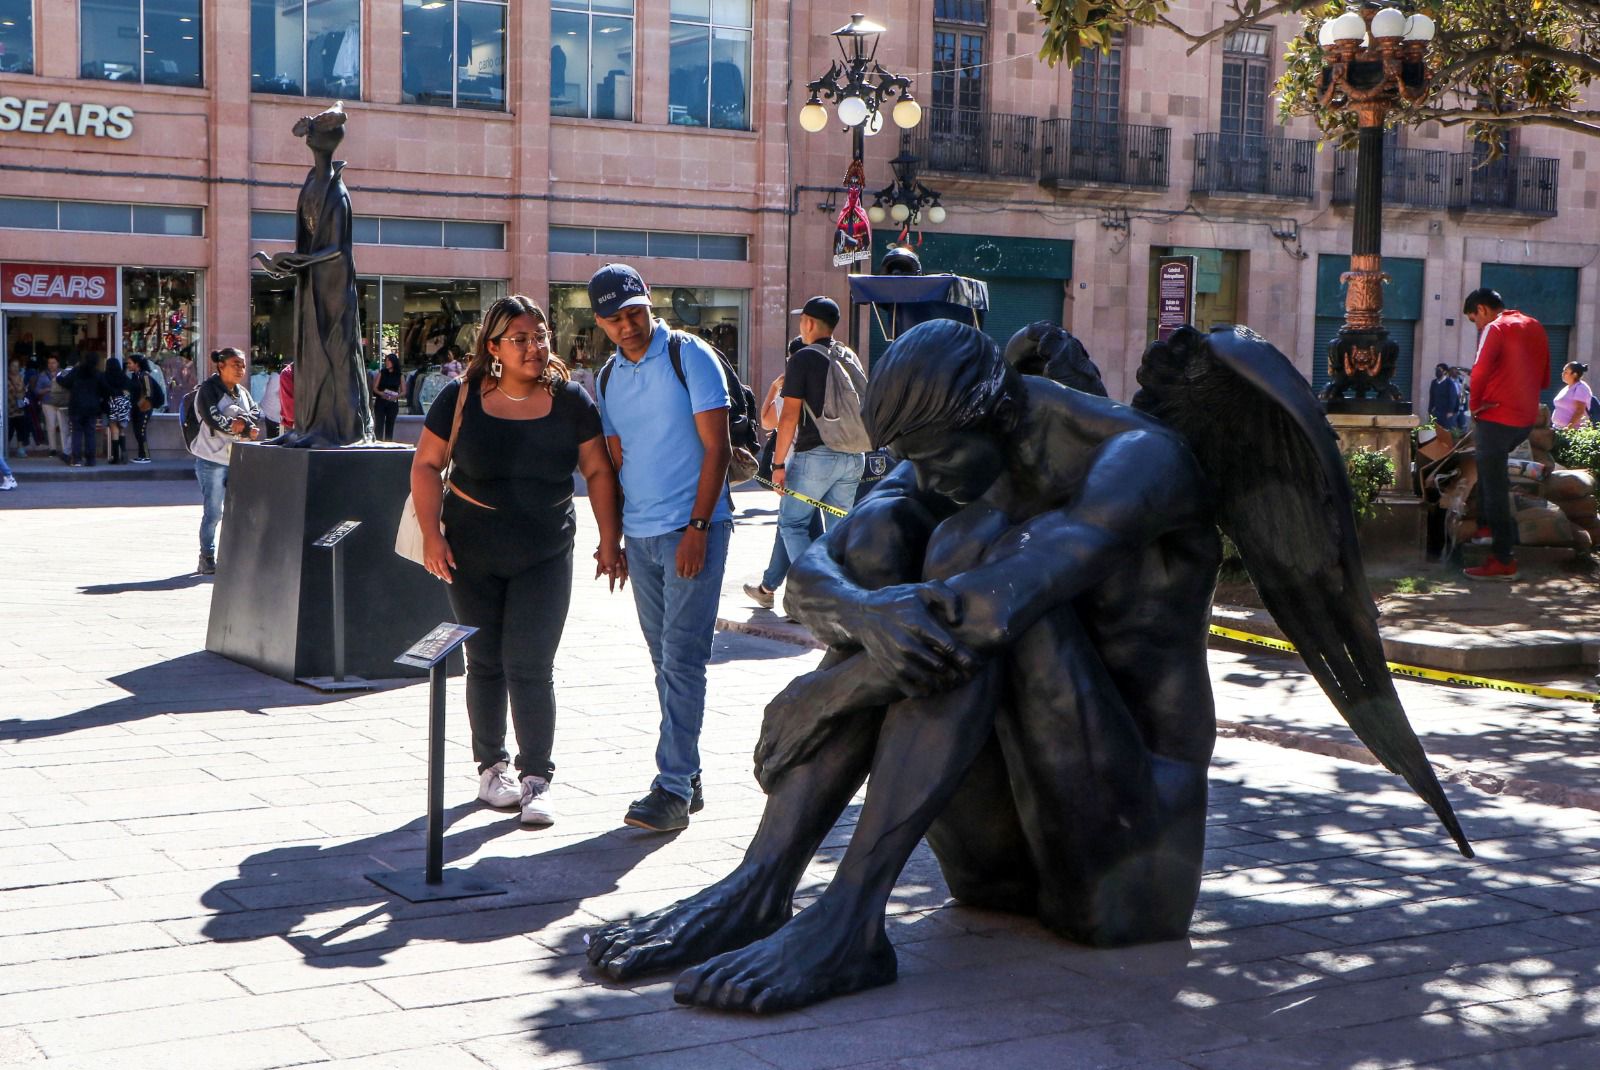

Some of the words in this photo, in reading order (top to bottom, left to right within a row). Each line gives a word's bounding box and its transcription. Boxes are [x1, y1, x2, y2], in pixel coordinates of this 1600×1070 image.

[0, 96, 134, 139] SEARS
[11, 273, 105, 300] SEARS
[598, 291, 617, 304] BUGS
